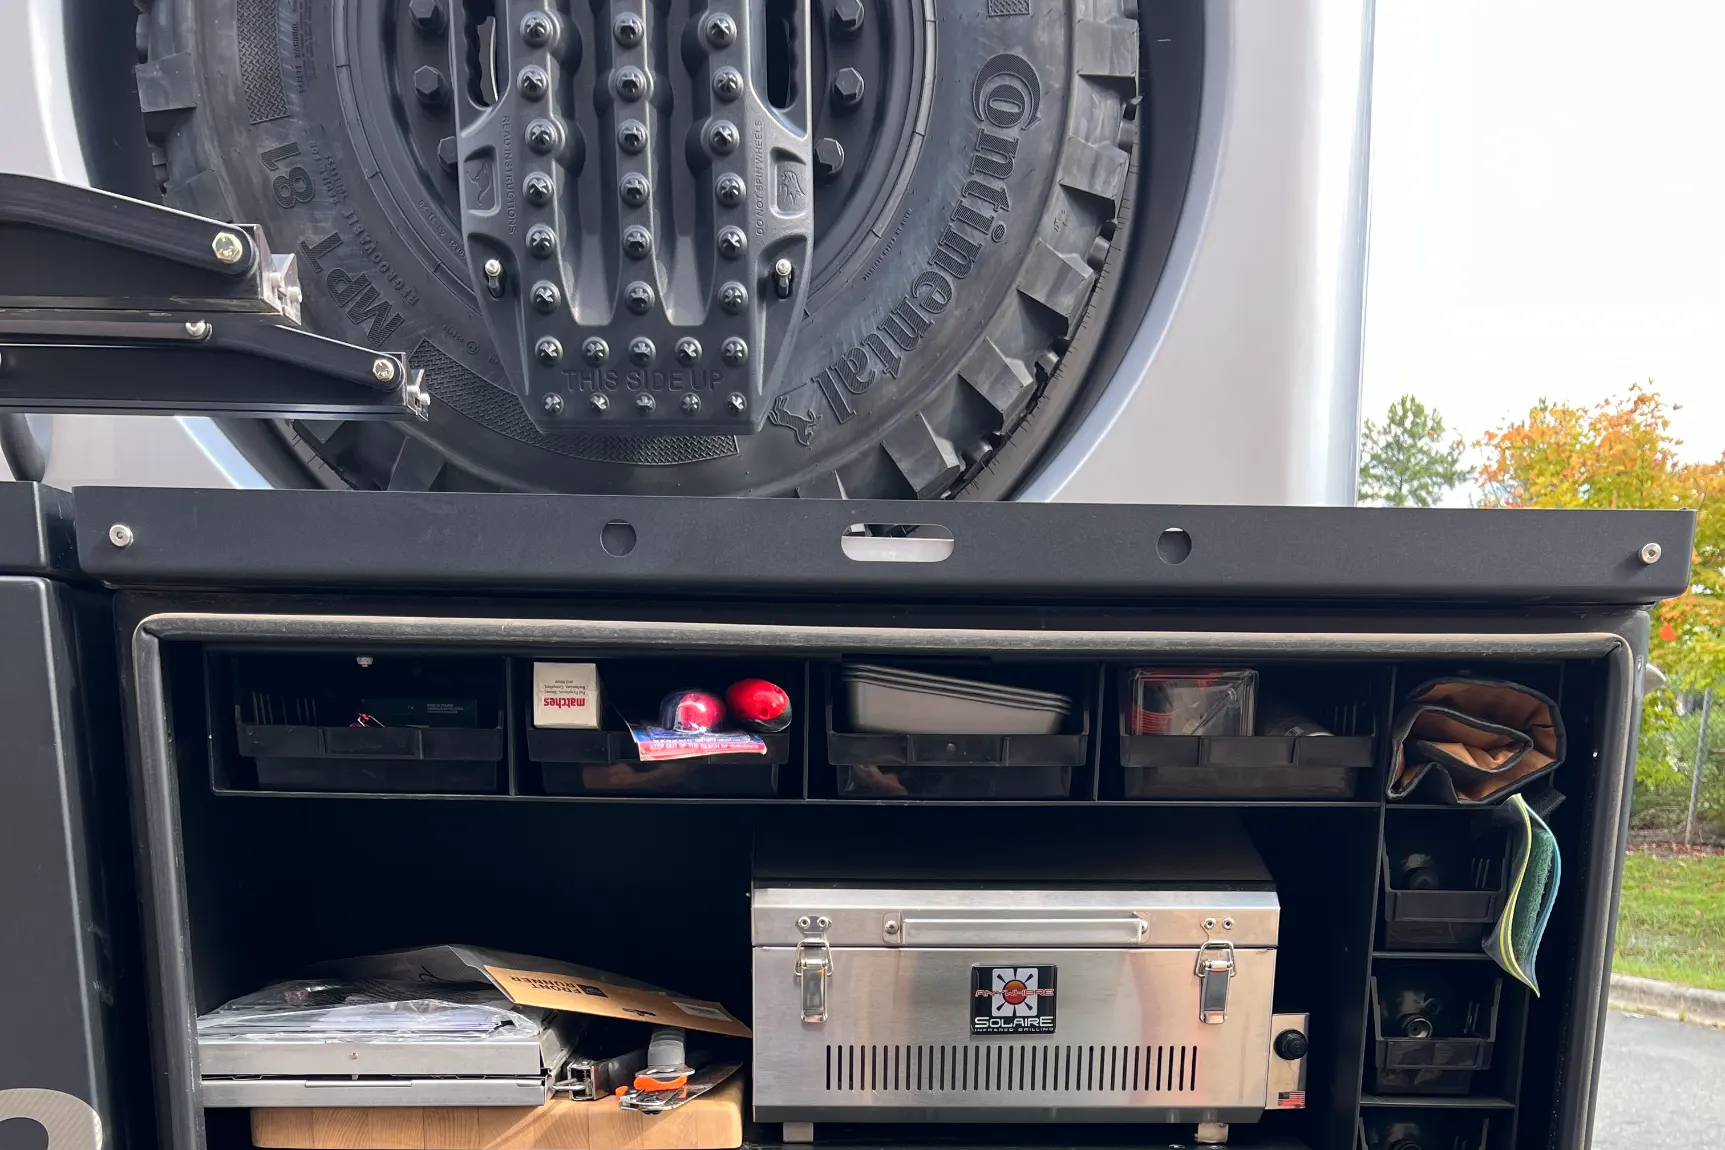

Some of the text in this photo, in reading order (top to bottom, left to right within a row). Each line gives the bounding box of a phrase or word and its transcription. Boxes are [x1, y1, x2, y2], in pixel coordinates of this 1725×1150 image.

[502, 115, 517, 235] READ INSTRUCTIONS
[754, 120, 764, 236] DO NOT SPIN WHEELS
[260, 141, 405, 348] MPT 81
[811, 52, 1041, 424] Continental
[341, 207, 420, 306] REGROOVABLE
[561, 369, 724, 392] THIS SIDE UP
[543, 697, 586, 709] matches
[509, 975, 577, 988] RUNNER
[531, 983, 582, 994] FRONT
[975, 988, 1054, 997] ANYWHERE
[974, 1016, 1054, 1028] SOLAIRE
